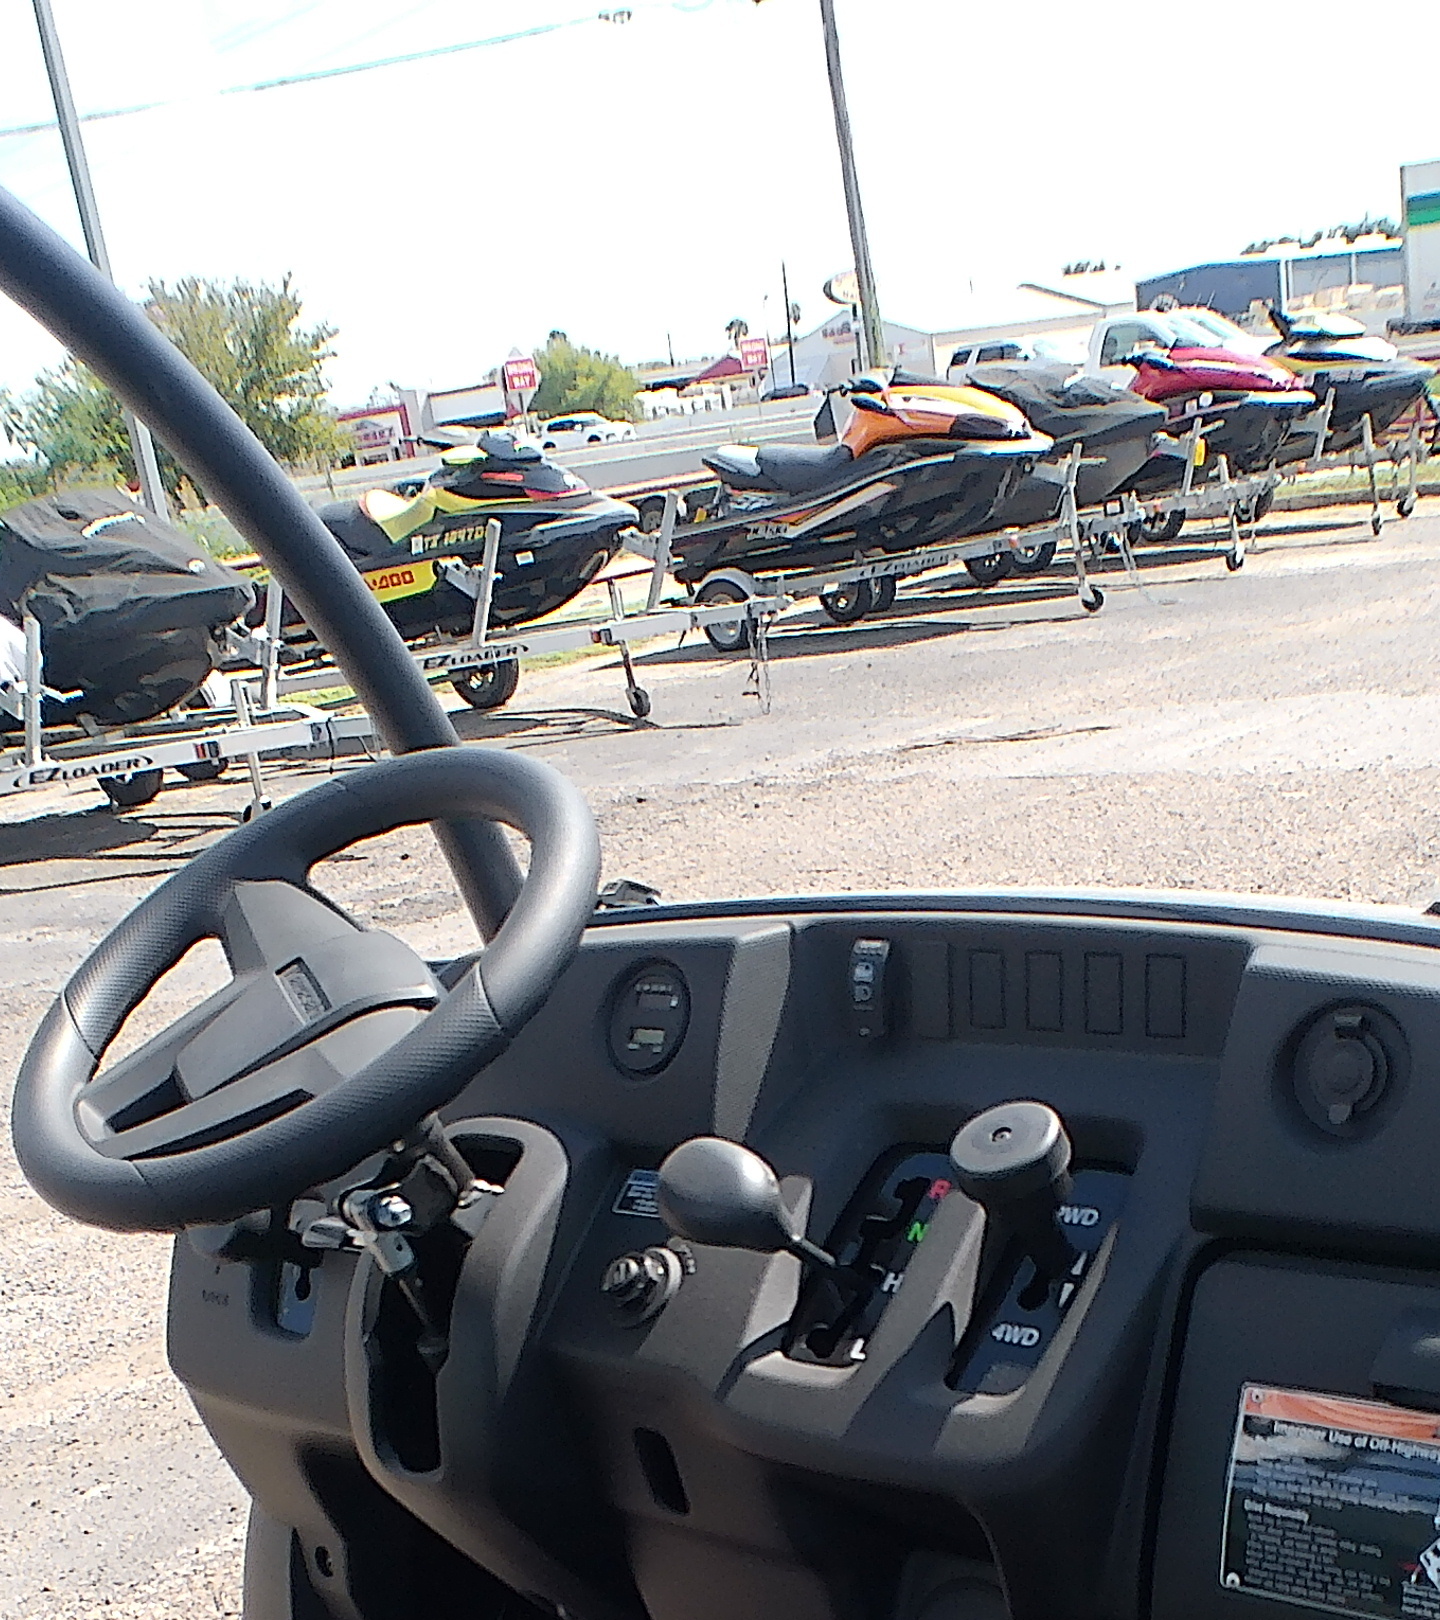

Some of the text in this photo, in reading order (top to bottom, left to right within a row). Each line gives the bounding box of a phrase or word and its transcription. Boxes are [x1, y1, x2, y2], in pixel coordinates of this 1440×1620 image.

[929, 1178, 952, 1200] R
[907, 1221, 930, 1243] N
[881, 1271, 906, 1294] H
[991, 1323, 1041, 1347] 4WD
[849, 1337, 867, 1361] L
[1328, 1429, 1352, 1448] Use
[1354, 1433, 1369, 1449] of
